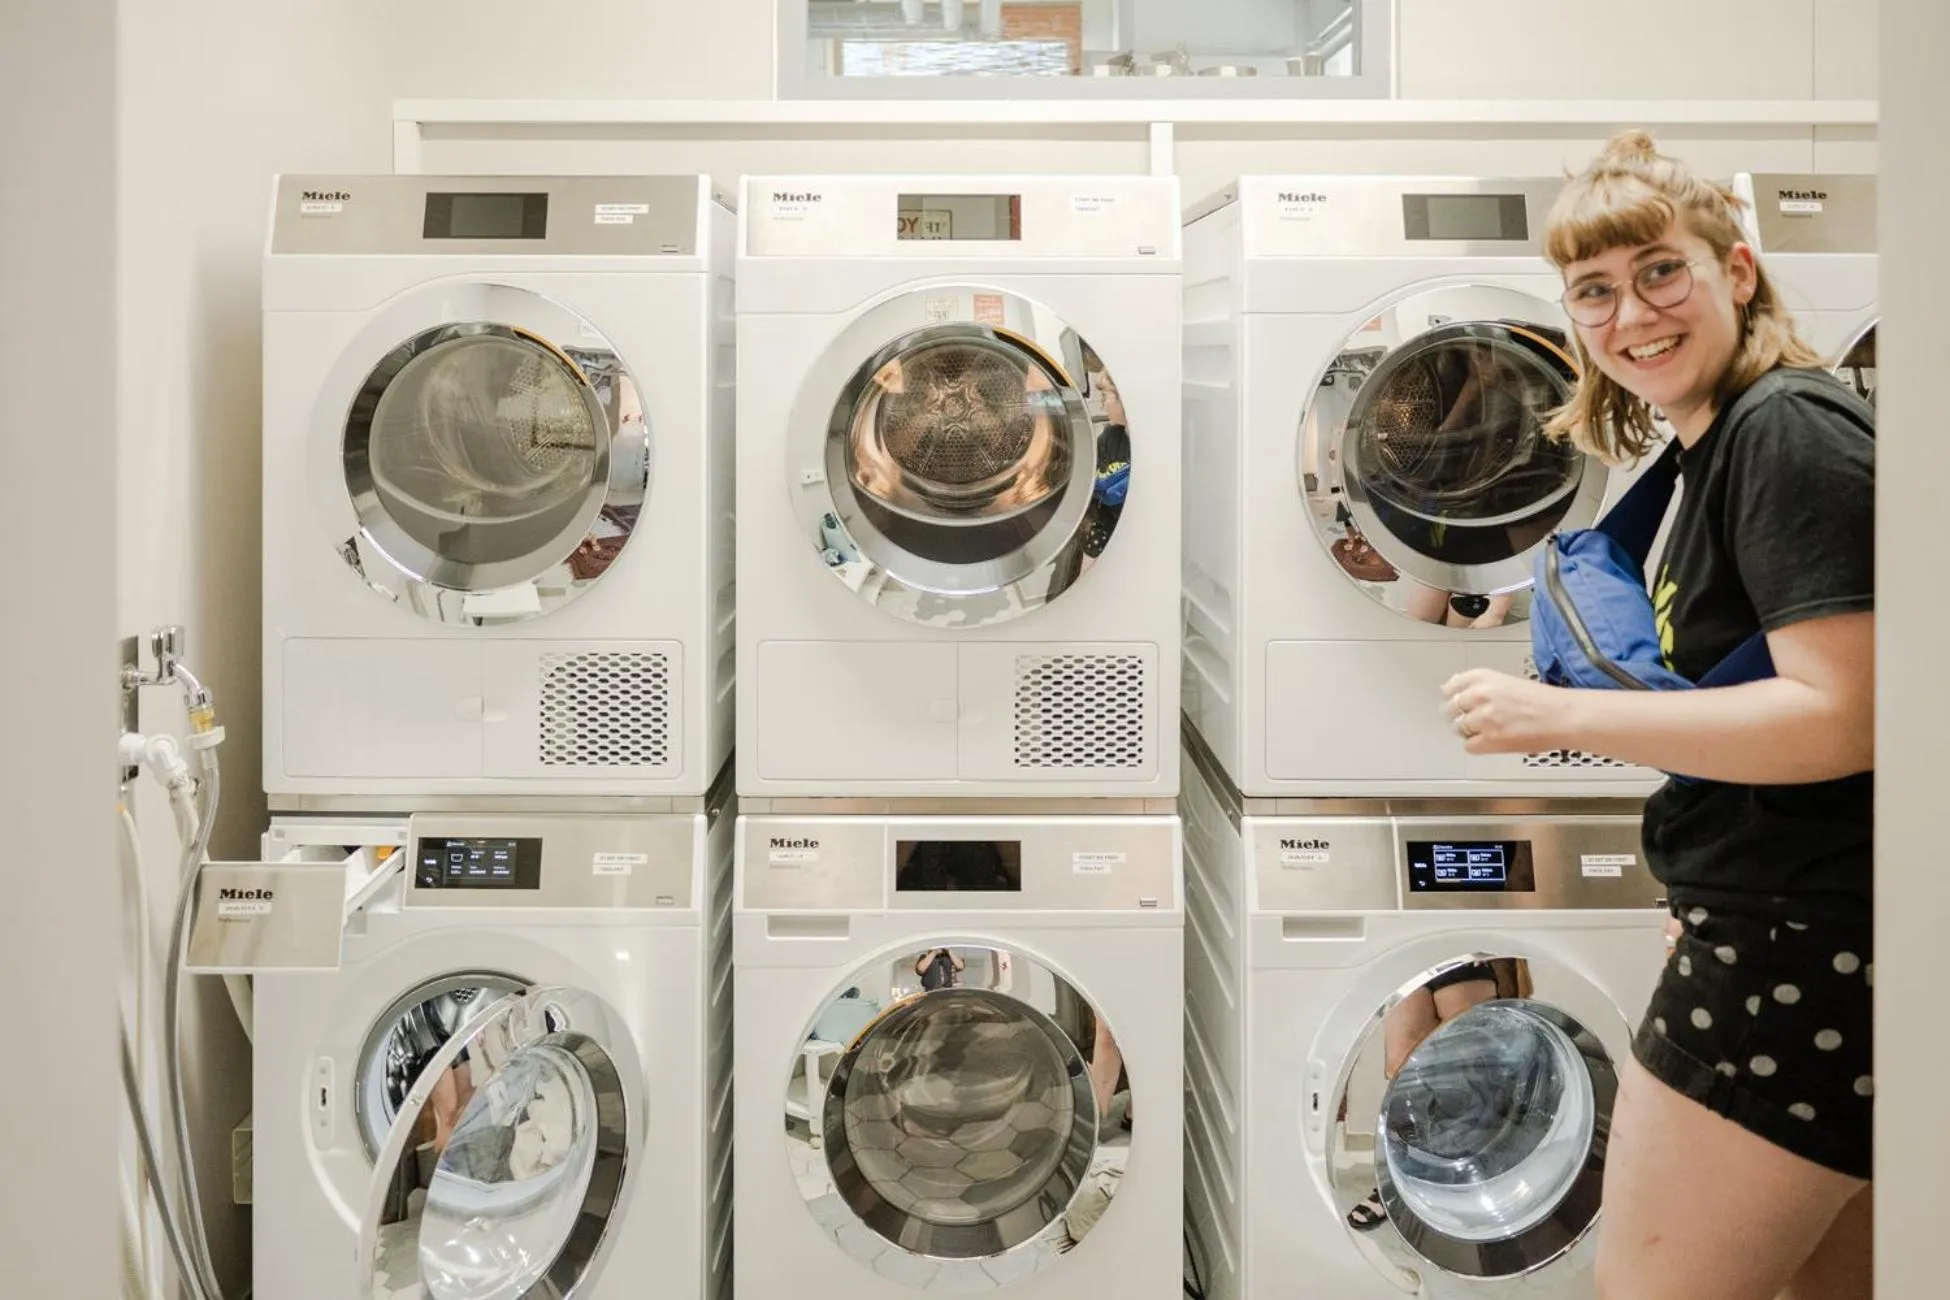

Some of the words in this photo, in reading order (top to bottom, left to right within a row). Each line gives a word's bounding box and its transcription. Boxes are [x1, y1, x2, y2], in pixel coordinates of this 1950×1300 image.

[302, 191, 351, 200] Miele
[773, 192, 821, 201] Miele
[1278, 192, 1326, 201] Miele
[1779, 190, 1827, 200] Miele
[770, 838, 819, 848] Miele
[1280, 839, 1330, 849] Miele
[219, 888, 273, 900] Miele
